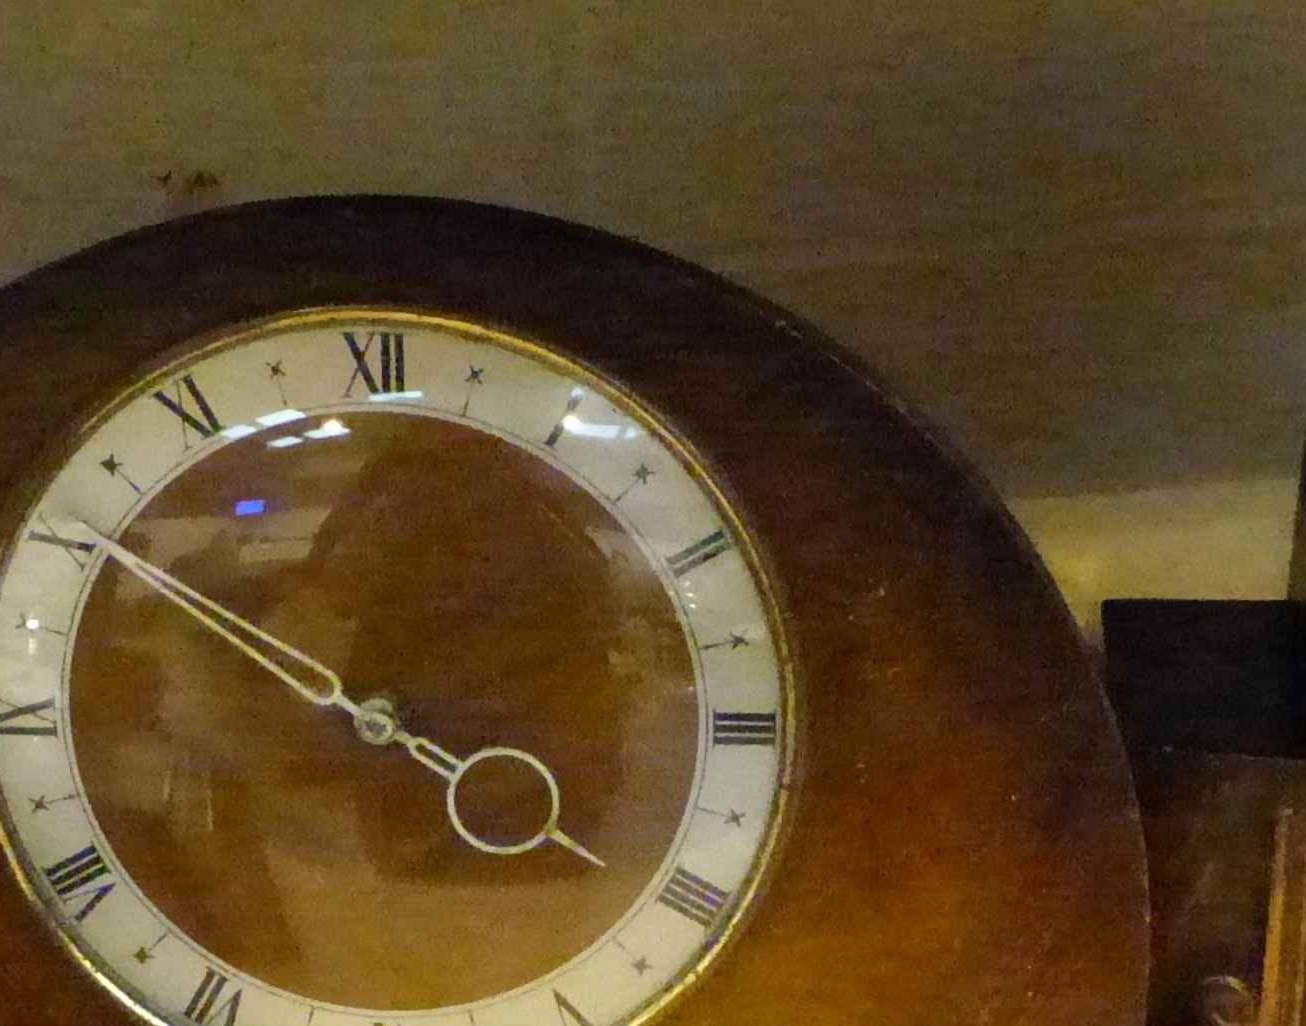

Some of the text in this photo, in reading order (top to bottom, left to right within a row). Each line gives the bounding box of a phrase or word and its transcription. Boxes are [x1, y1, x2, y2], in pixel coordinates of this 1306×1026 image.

[342, 331, 406, 398] XII
[153, 374, 223, 452] XI
[667, 529, 733, 577] II
[712, 710, 778, 747] III
[44, 845, 116, 921] VIII
